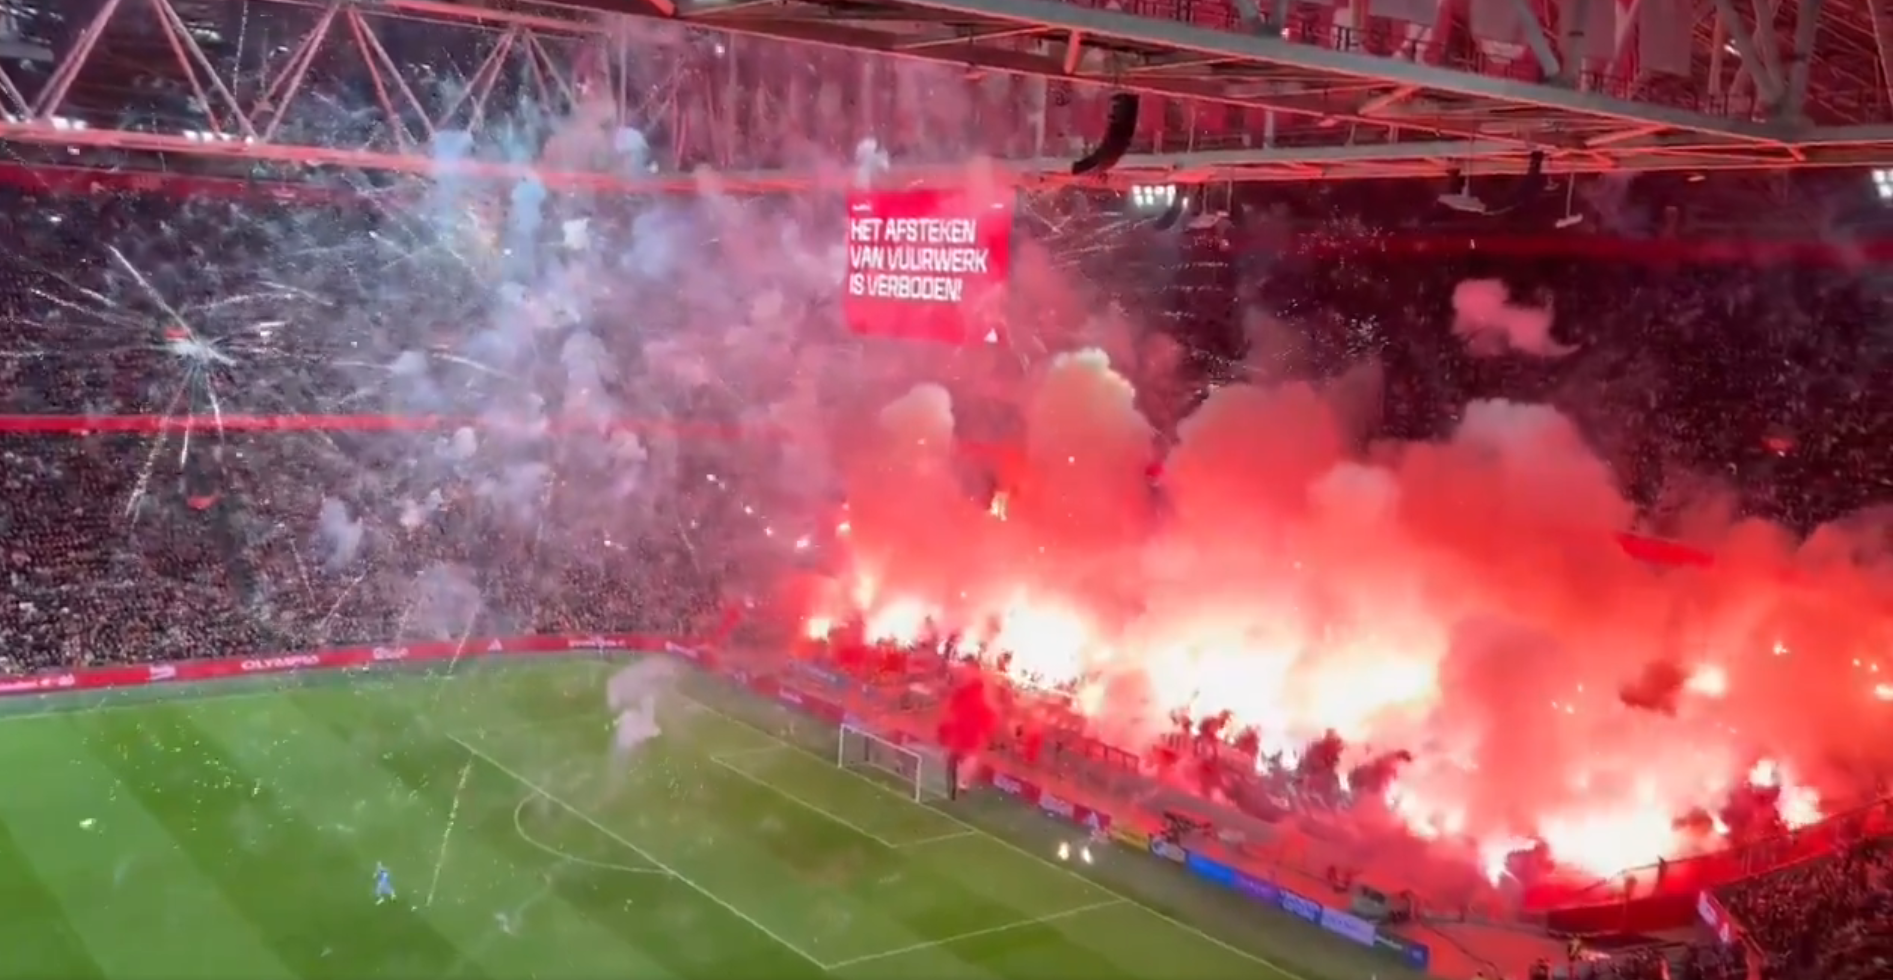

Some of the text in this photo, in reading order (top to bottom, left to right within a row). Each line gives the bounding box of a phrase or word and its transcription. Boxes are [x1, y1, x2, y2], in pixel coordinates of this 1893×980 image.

[851, 217, 976, 243] HET AFSTEKEN
[850, 245, 988, 272] VAN VUURWERK
[849, 273, 963, 302] IS VERBODEN!
